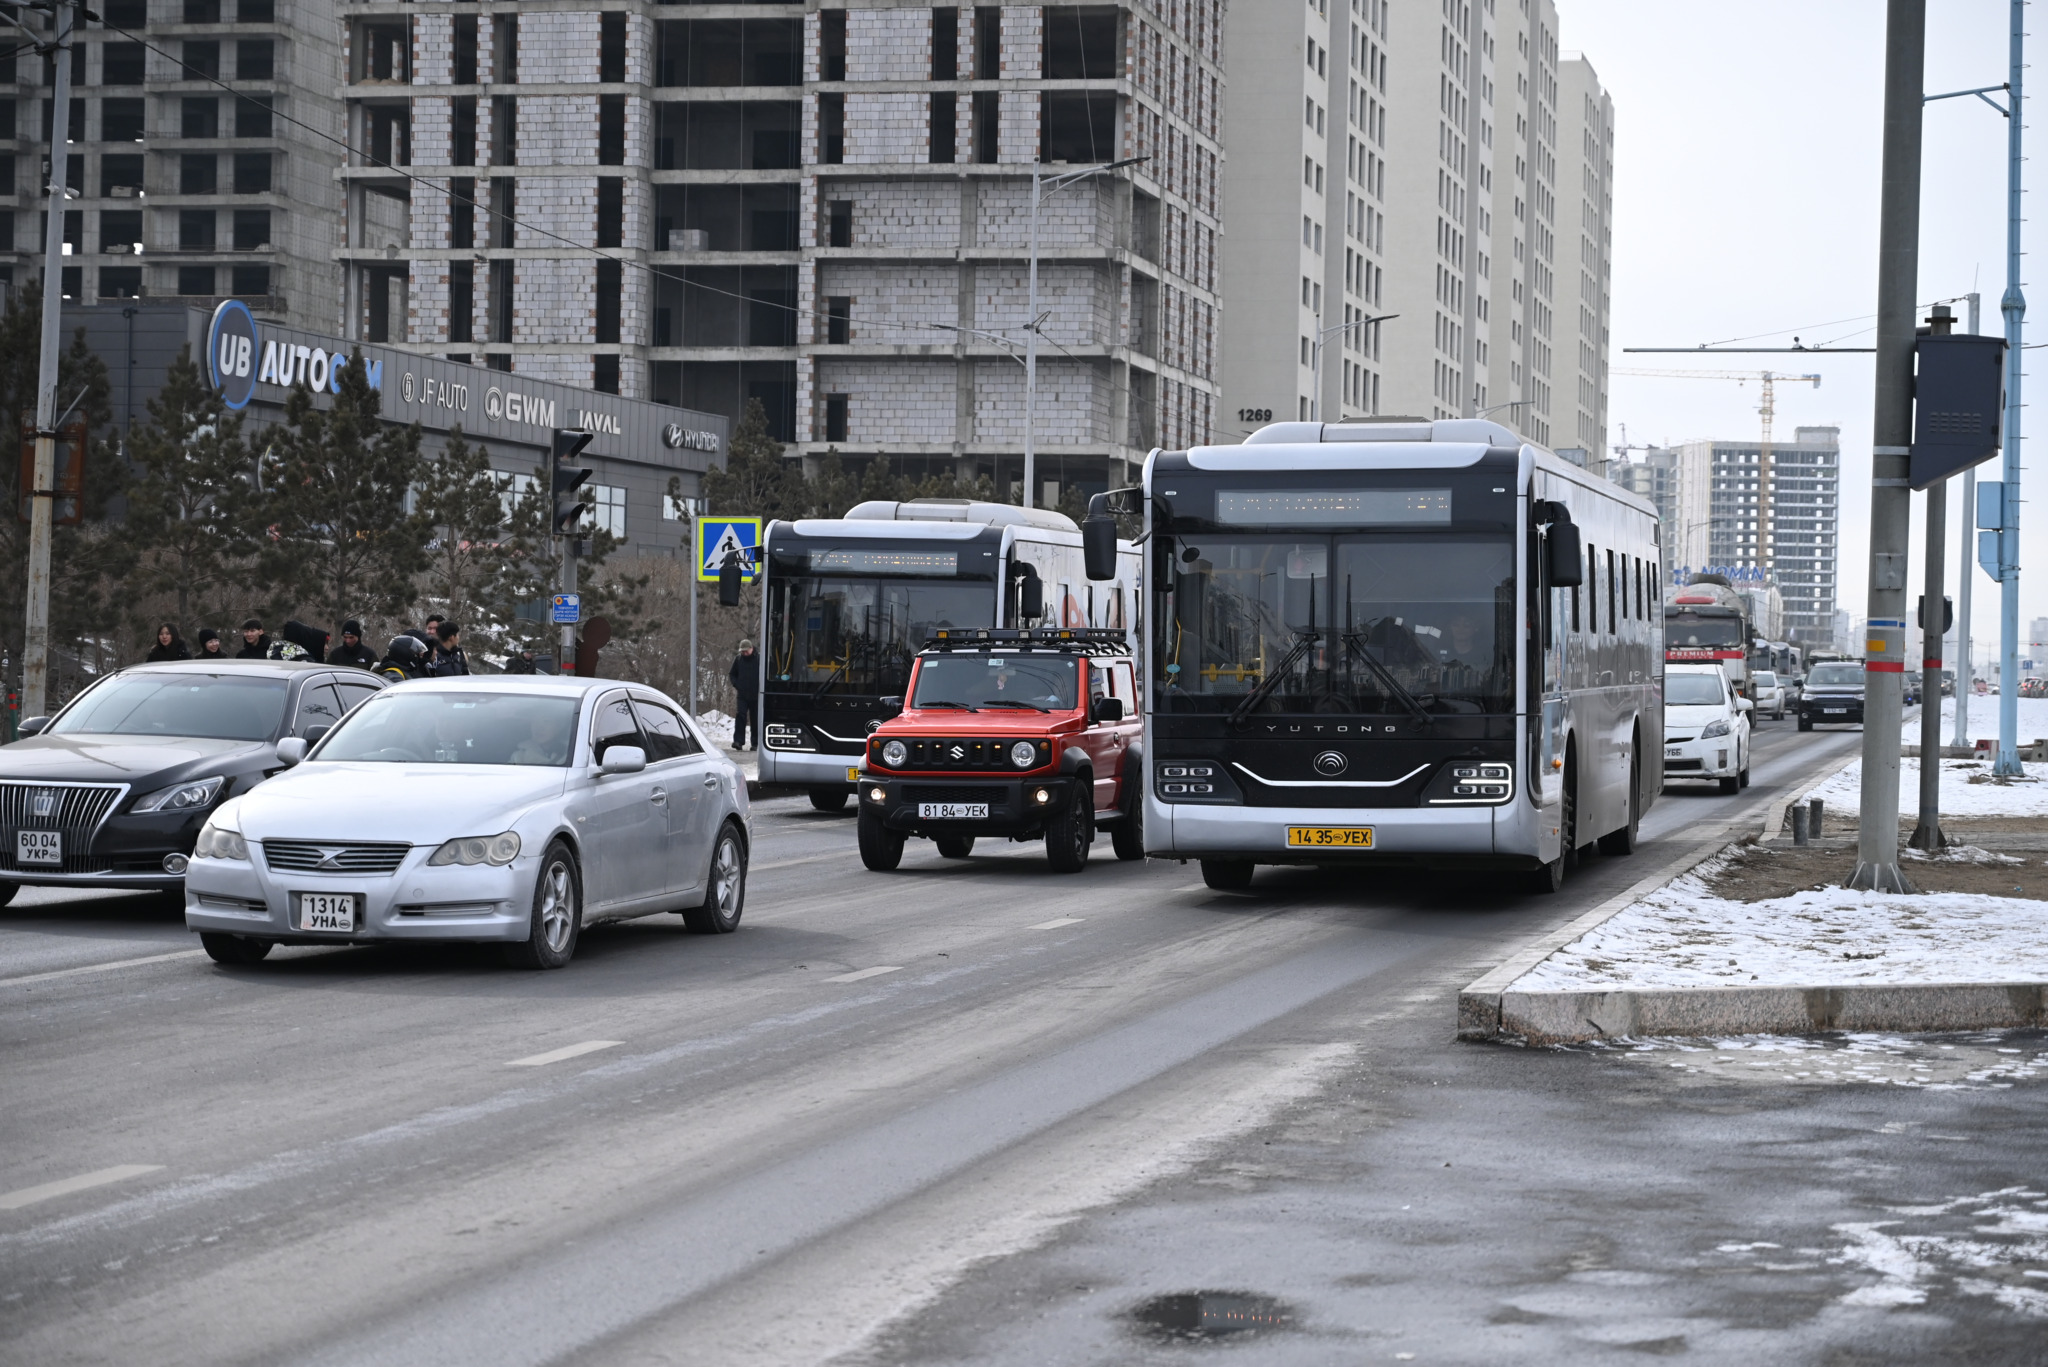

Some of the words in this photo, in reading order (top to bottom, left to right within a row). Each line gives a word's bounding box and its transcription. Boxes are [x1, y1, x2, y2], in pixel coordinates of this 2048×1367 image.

[219, 333, 252, 378] UB
[258, 340, 383, 394] AUTOCM
[419, 377, 435, 404] JF
[437, 381, 468, 411] AUTO
[505, 391, 555, 428] GWM
[1238, 408, 1273, 422] 1269
[1266, 725, 1396, 733] YUTONG
[309, 897, 347, 915] 1314
